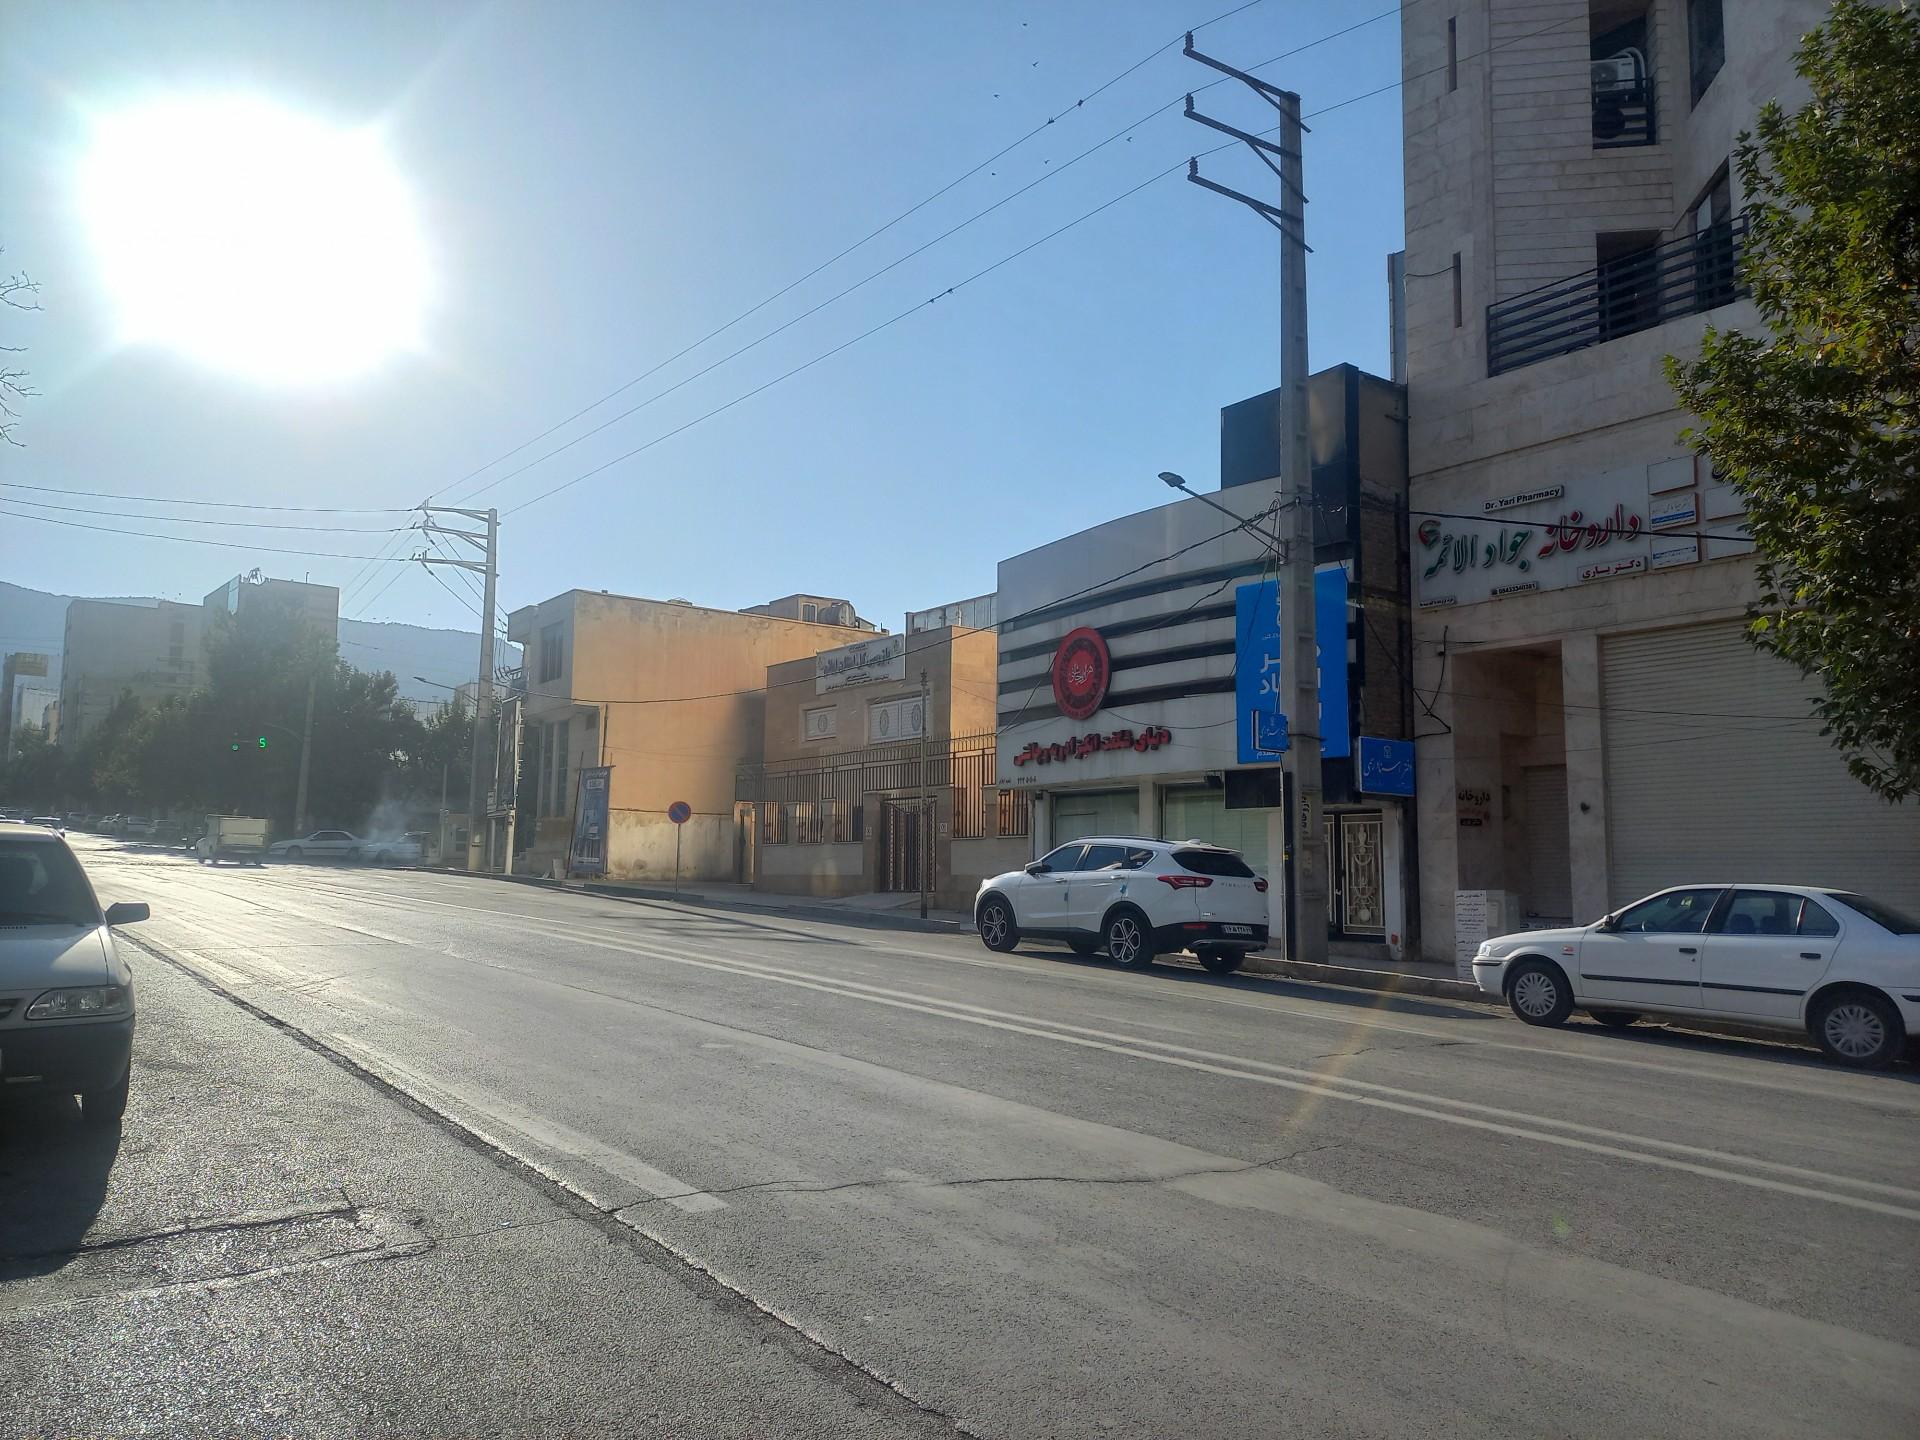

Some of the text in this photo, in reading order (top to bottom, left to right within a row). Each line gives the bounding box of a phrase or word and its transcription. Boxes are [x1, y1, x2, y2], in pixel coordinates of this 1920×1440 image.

[1485, 488, 1560, 510] Dr. Yari Pharmacy
[1583, 560, 1641, 579] دکتر یاری
[259, 737, 266, 748] 5
[1458, 790, 1491, 806] داروخانه
